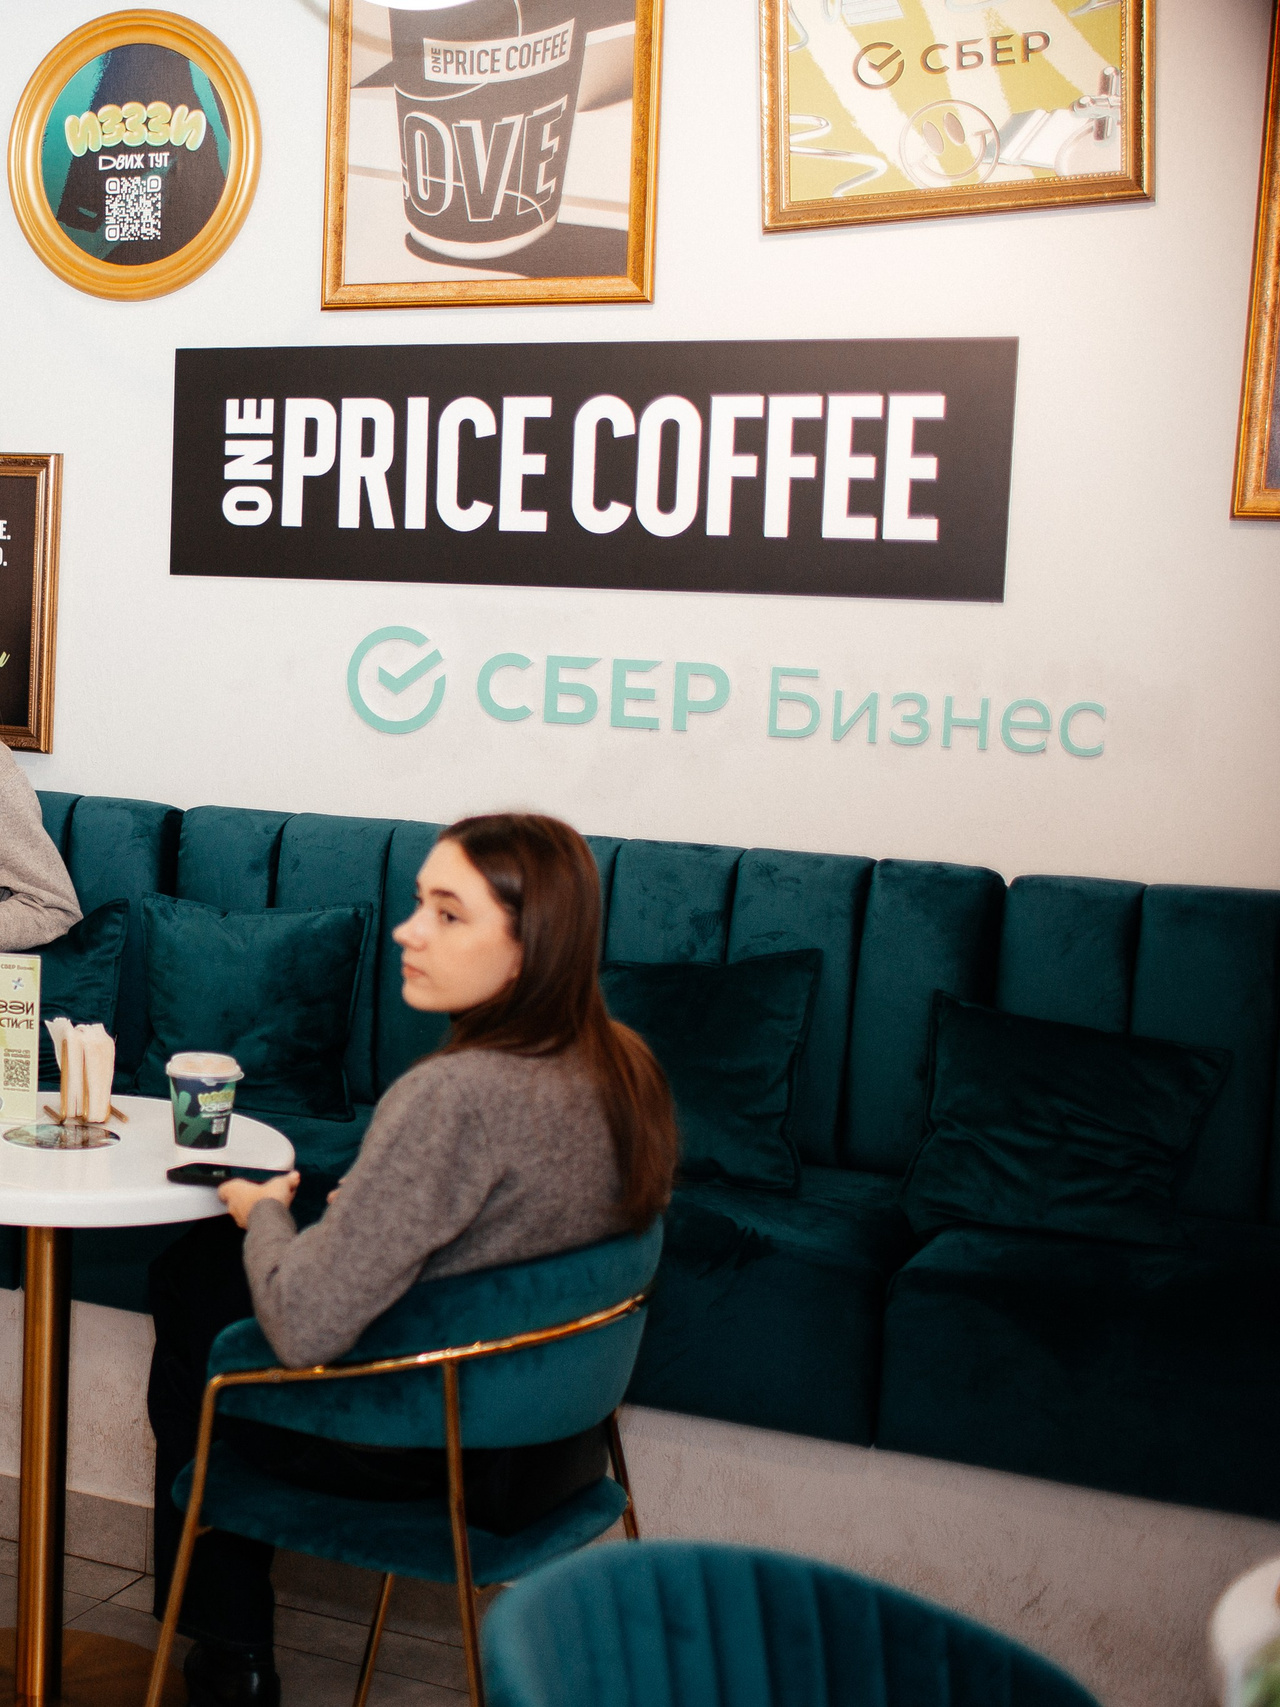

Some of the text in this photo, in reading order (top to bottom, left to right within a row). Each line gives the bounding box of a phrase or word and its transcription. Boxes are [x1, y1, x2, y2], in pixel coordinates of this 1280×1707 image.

[431, 29, 569, 75] ONE PRICE COFFEE
[920, 30, 1051, 75] СБЕР
[401, 94, 568, 222] OVE
[222, 393, 947, 544] ONE PRICE COFFEE
[476, 652, 1109, 758] СБЕР Бизнес
